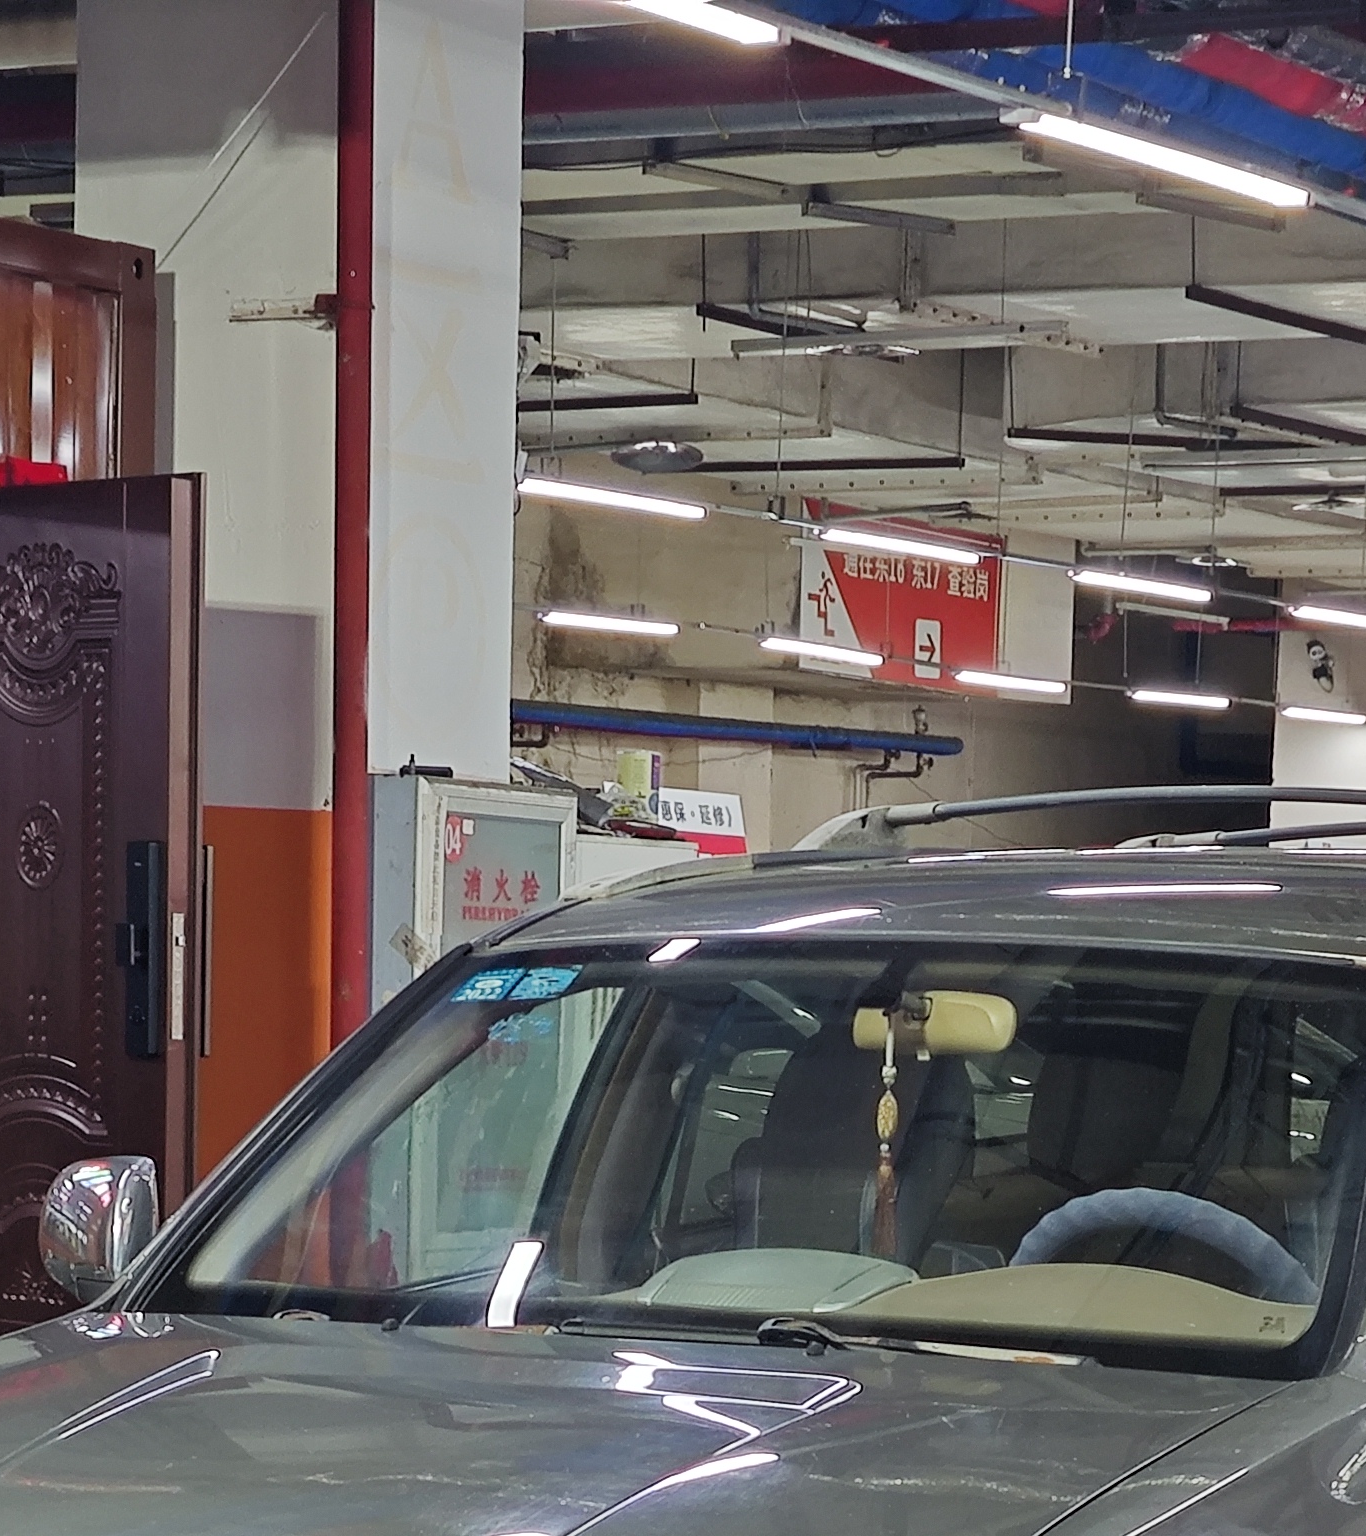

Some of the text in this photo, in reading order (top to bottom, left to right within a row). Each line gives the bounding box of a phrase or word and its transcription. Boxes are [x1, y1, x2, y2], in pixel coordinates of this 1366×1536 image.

[444, 823, 463, 856] 04
[463, 866, 541, 904] 消火栓
